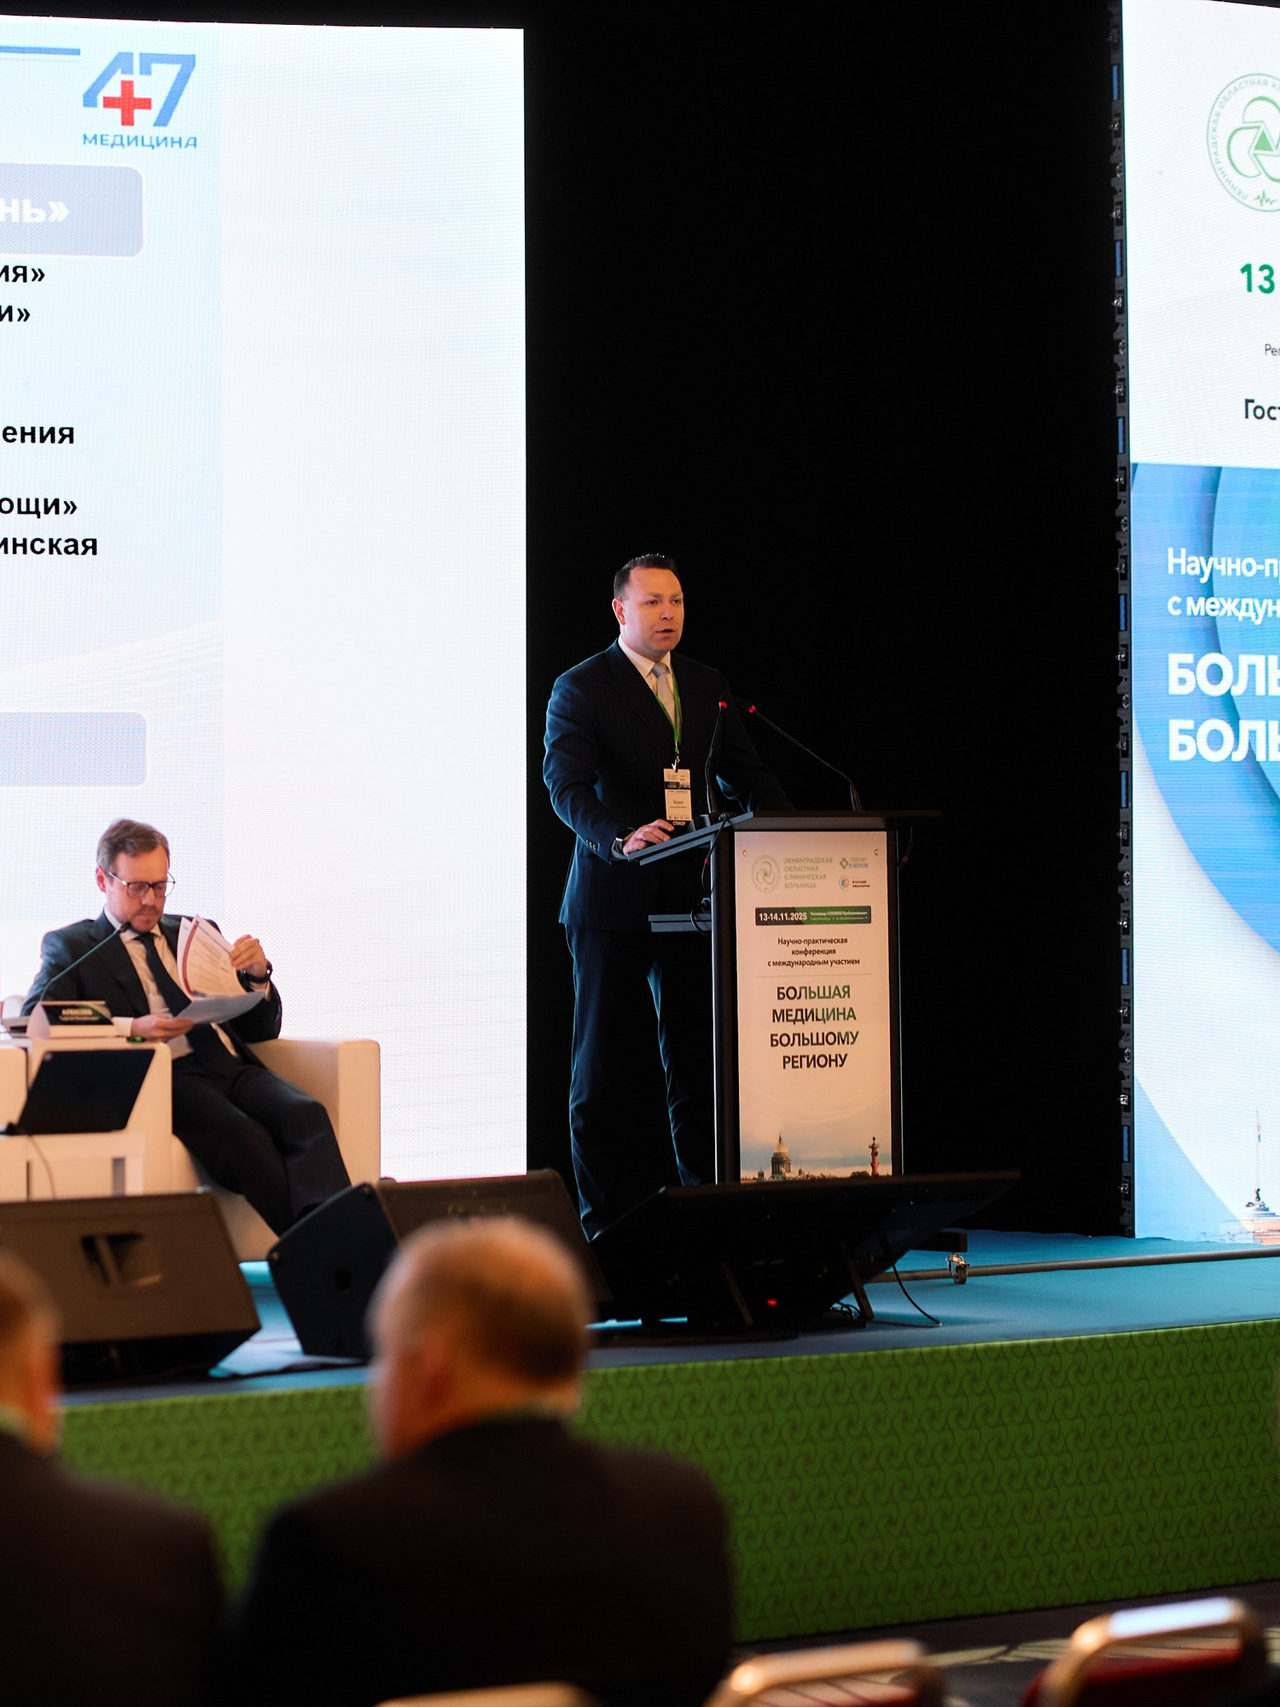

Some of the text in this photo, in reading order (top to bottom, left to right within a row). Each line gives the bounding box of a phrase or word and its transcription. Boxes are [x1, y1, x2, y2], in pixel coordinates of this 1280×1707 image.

[82, 133, 198, 150] МЕДИЦИНА
[1240, 263, 1276, 294] 13
[1244, 398, 1280, 421] Гос
[1167, 547, 1280, 584] Научно-п
[1167, 595, 1182, 616] с
[759, 911, 808, 922] 13-14.11.2025
[777, 937, 848, 947] Научно-практическая
[791, 947, 837, 957] конференция
[772, 958, 829, 968] международным
[829, 957, 861, 967] участием
[776, 985, 851, 1001] БОЛЬШАЯ
[772, 1007, 857, 1025] МЕДИЦИНА
[769, 1030, 860, 1049] БОЛЬШОМУ
[782, 1053, 848, 1069] РЕГИОНУ
